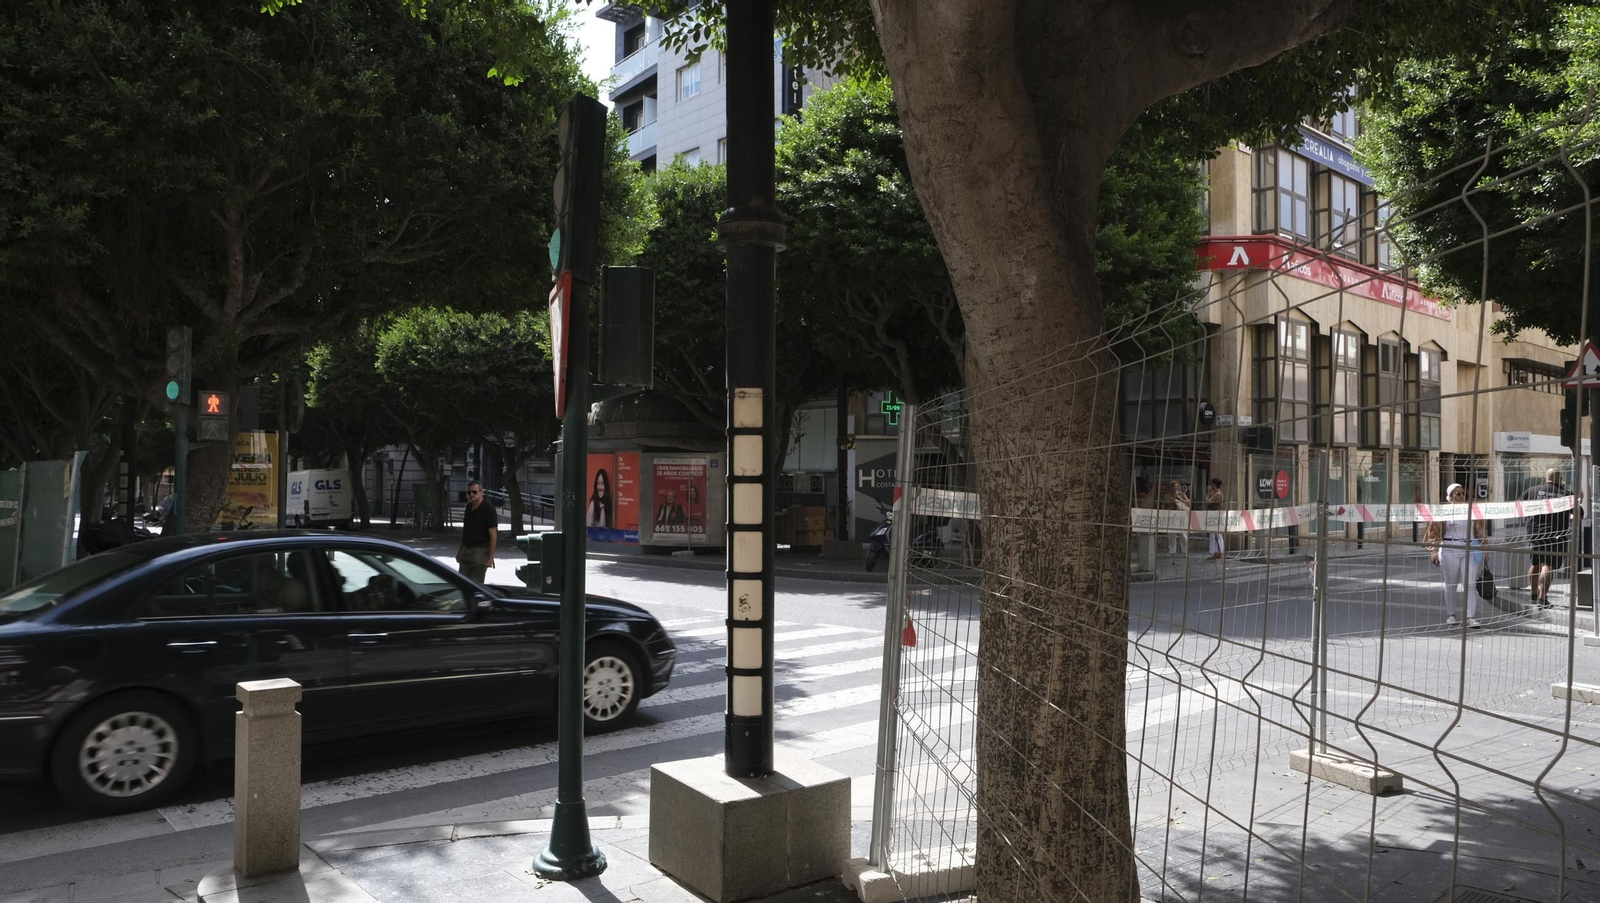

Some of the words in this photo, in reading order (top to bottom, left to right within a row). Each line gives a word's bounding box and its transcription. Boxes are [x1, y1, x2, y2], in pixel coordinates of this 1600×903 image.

[1304, 138, 1334, 163] CREALIA
[1338, 154, 1360, 173] abogados
[1331, 271, 1363, 287] AOGADO
[234, 473, 267, 482] JULIO
[291, 481, 302, 495] GLS
[315, 480, 342, 490] GLS
[655, 525, 670, 533] 662
[672, 525, 685, 533] 135
